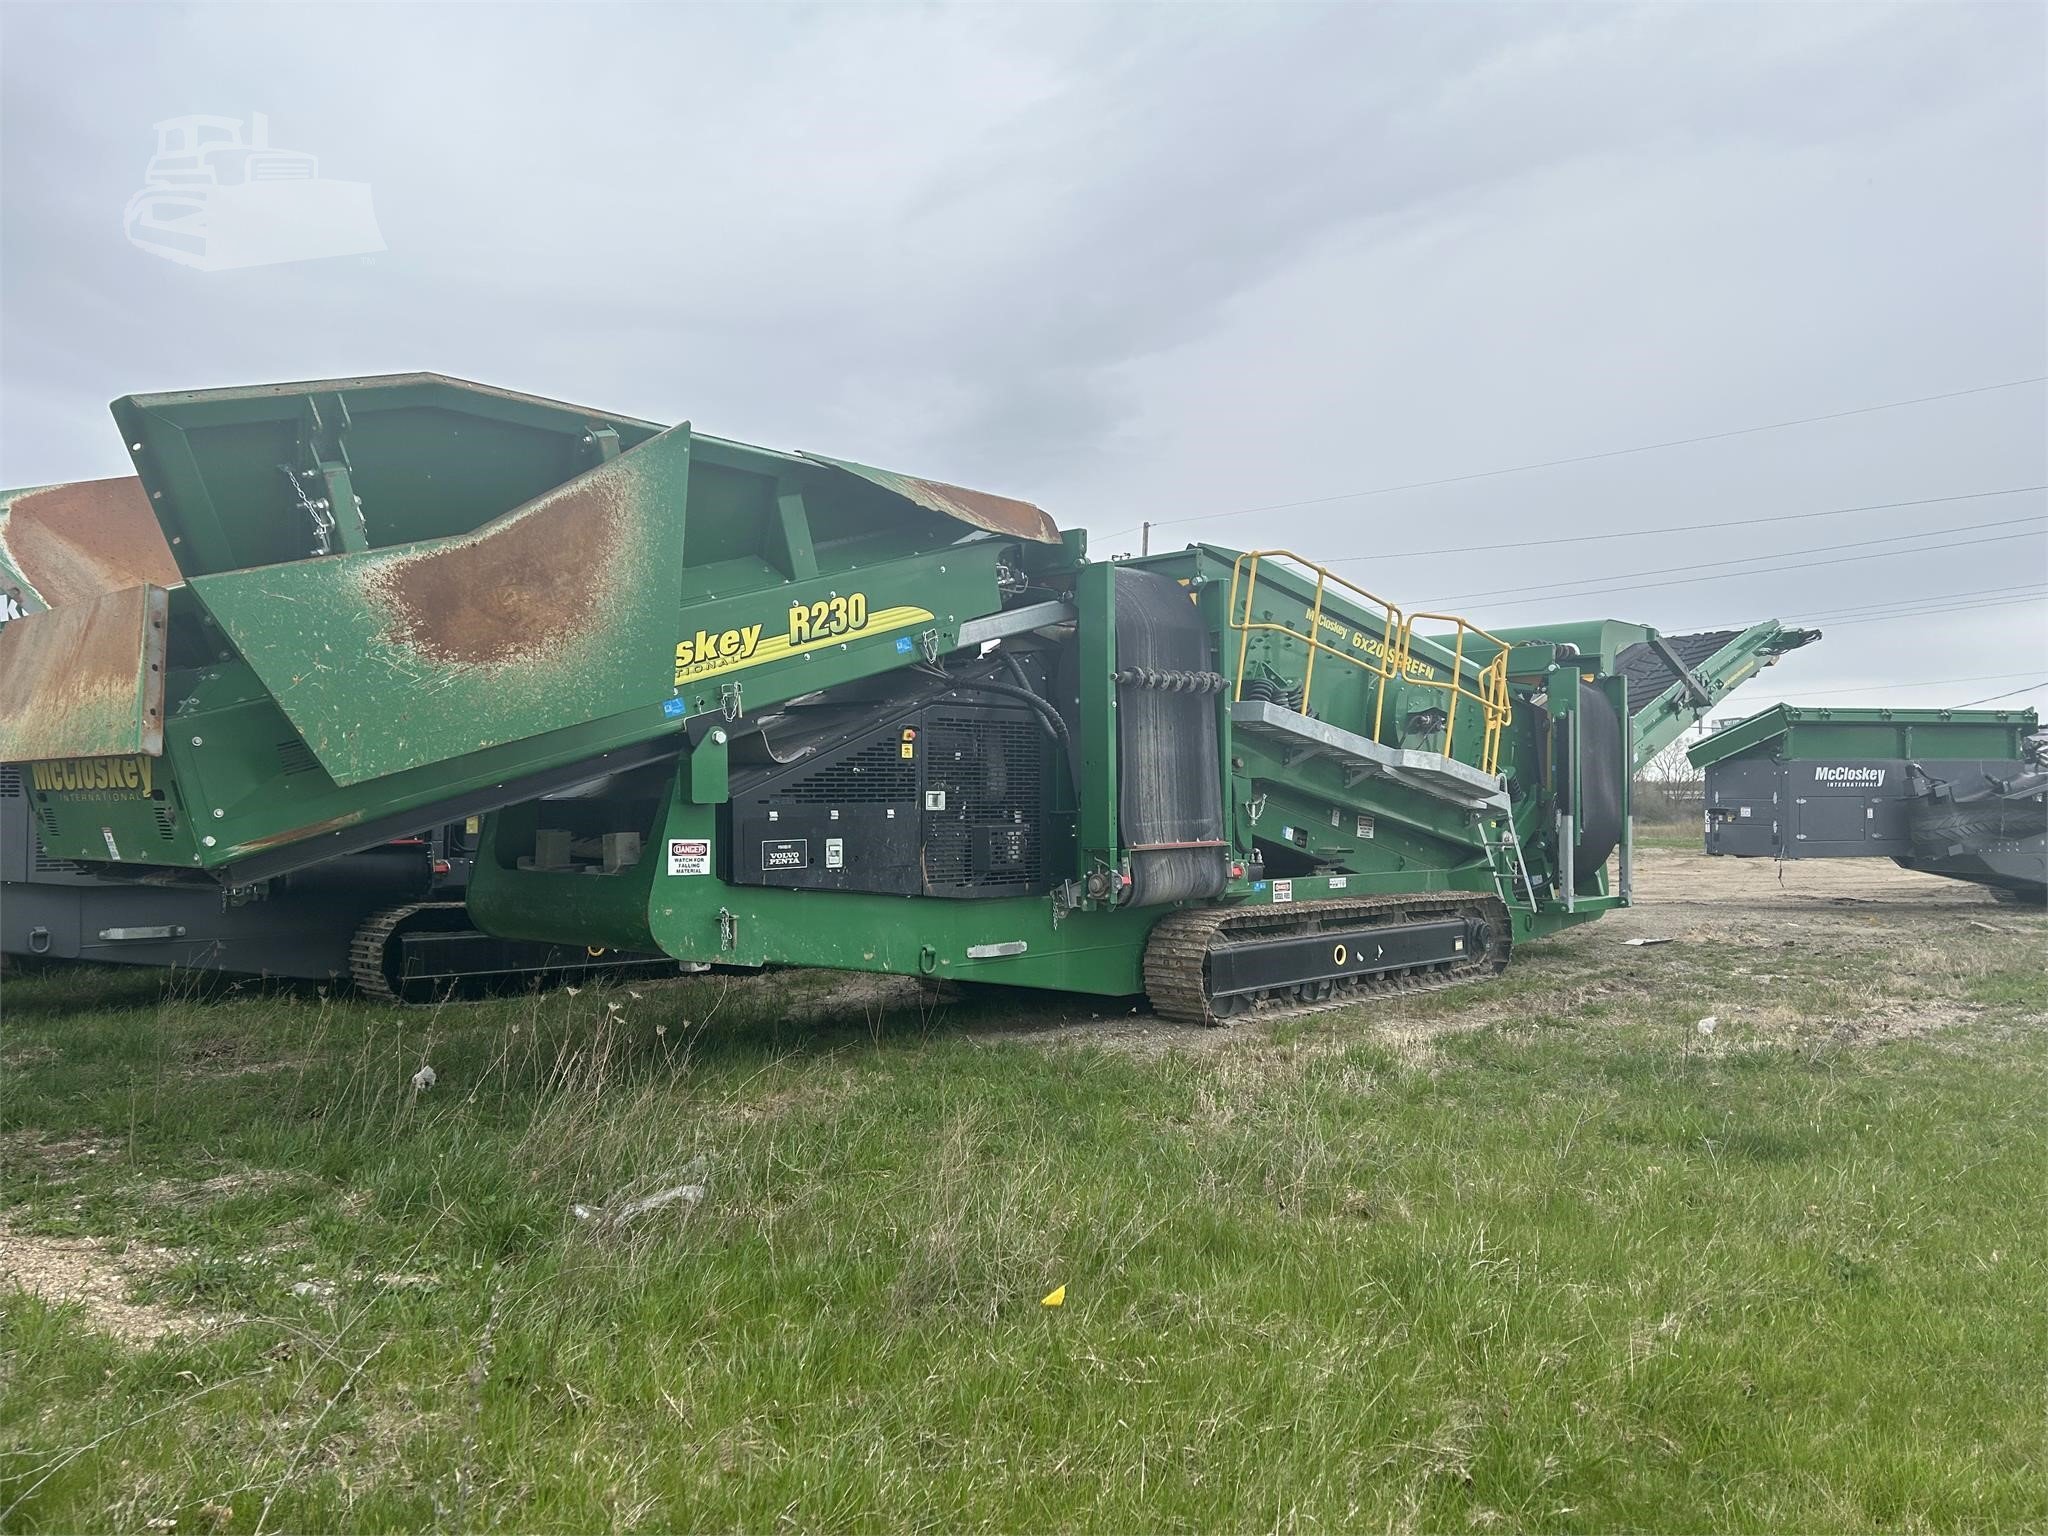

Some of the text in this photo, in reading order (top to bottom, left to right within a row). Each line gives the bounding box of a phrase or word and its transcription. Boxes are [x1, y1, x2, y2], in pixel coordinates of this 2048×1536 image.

[788, 592, 868, 646] R230
[1306, 608, 1348, 640] MCloskey
[1352, 632, 1385, 658] 6x20
[1815, 766, 1886, 787] McCloskey
[675, 845, 705, 853] DANGER
[769, 851, 800, 859] VOLVO
[769, 857, 801, 865] PENTA
